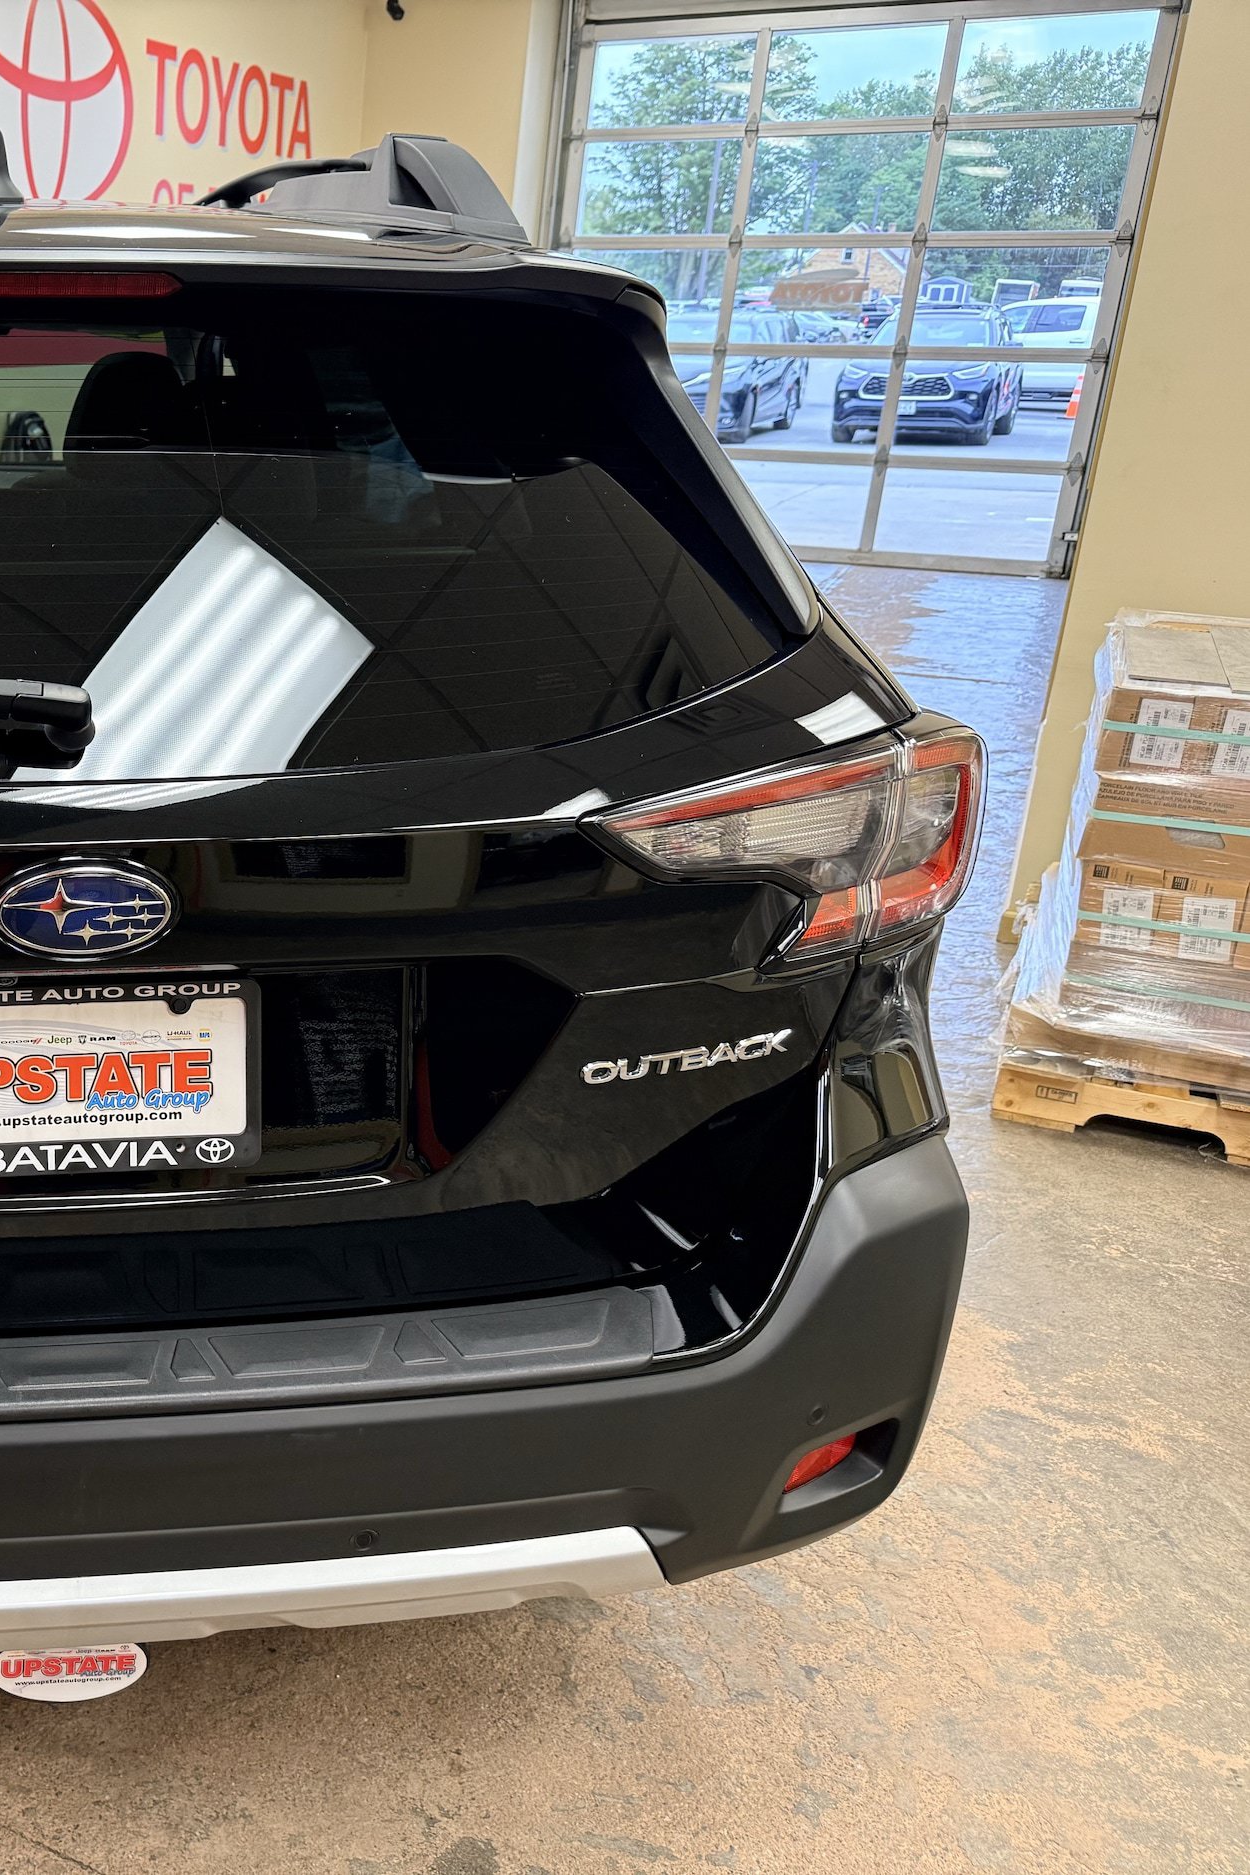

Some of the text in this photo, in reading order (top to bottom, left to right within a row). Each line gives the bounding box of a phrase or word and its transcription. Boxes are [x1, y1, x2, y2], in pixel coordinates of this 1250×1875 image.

[146, 38, 313, 161] TOYOTA
[41, 984, 125, 1001] AUTO
[133, 982, 242, 998] GROUP
[47, 1034, 73, 1046] Jeep
[581, 1028, 793, 1085] OUTBACK
[85, 1088, 213, 1114] Auto Group
[0, 1653, 137, 1679] UPSTATE
[14, 1677, 122, 1687] www.upstateautogroup.com
